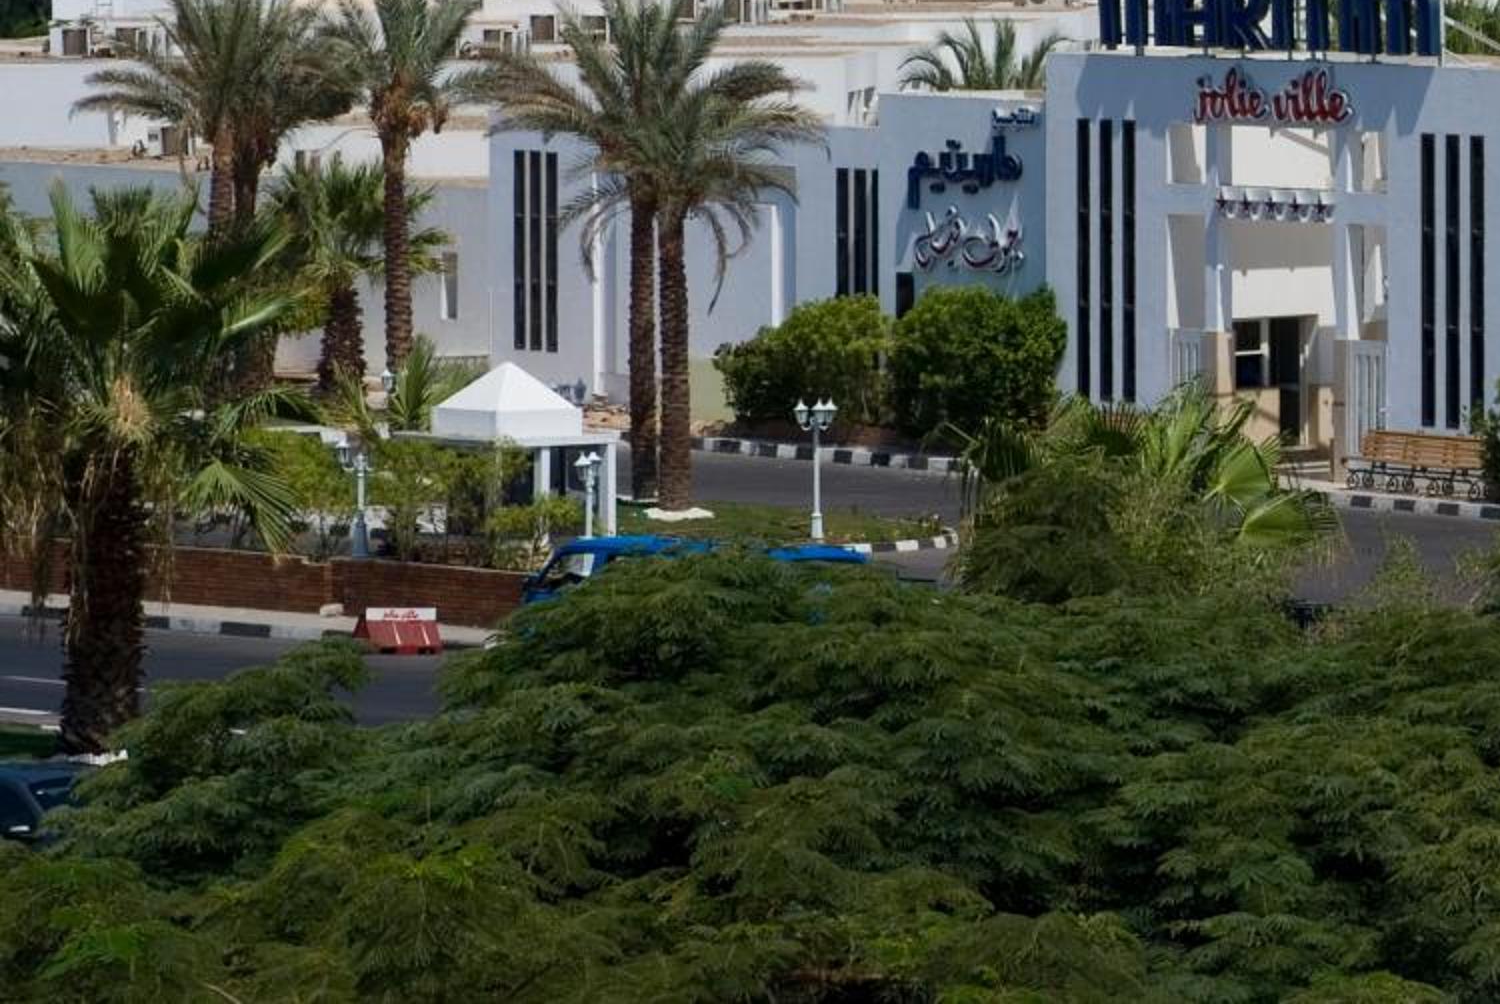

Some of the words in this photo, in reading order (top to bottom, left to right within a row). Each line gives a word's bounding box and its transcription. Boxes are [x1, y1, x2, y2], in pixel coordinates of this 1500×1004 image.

[1194, 67, 1268, 125] jolie
[1272, 68, 1354, 123] ville
[907, 134, 1023, 210] ماريتيم
